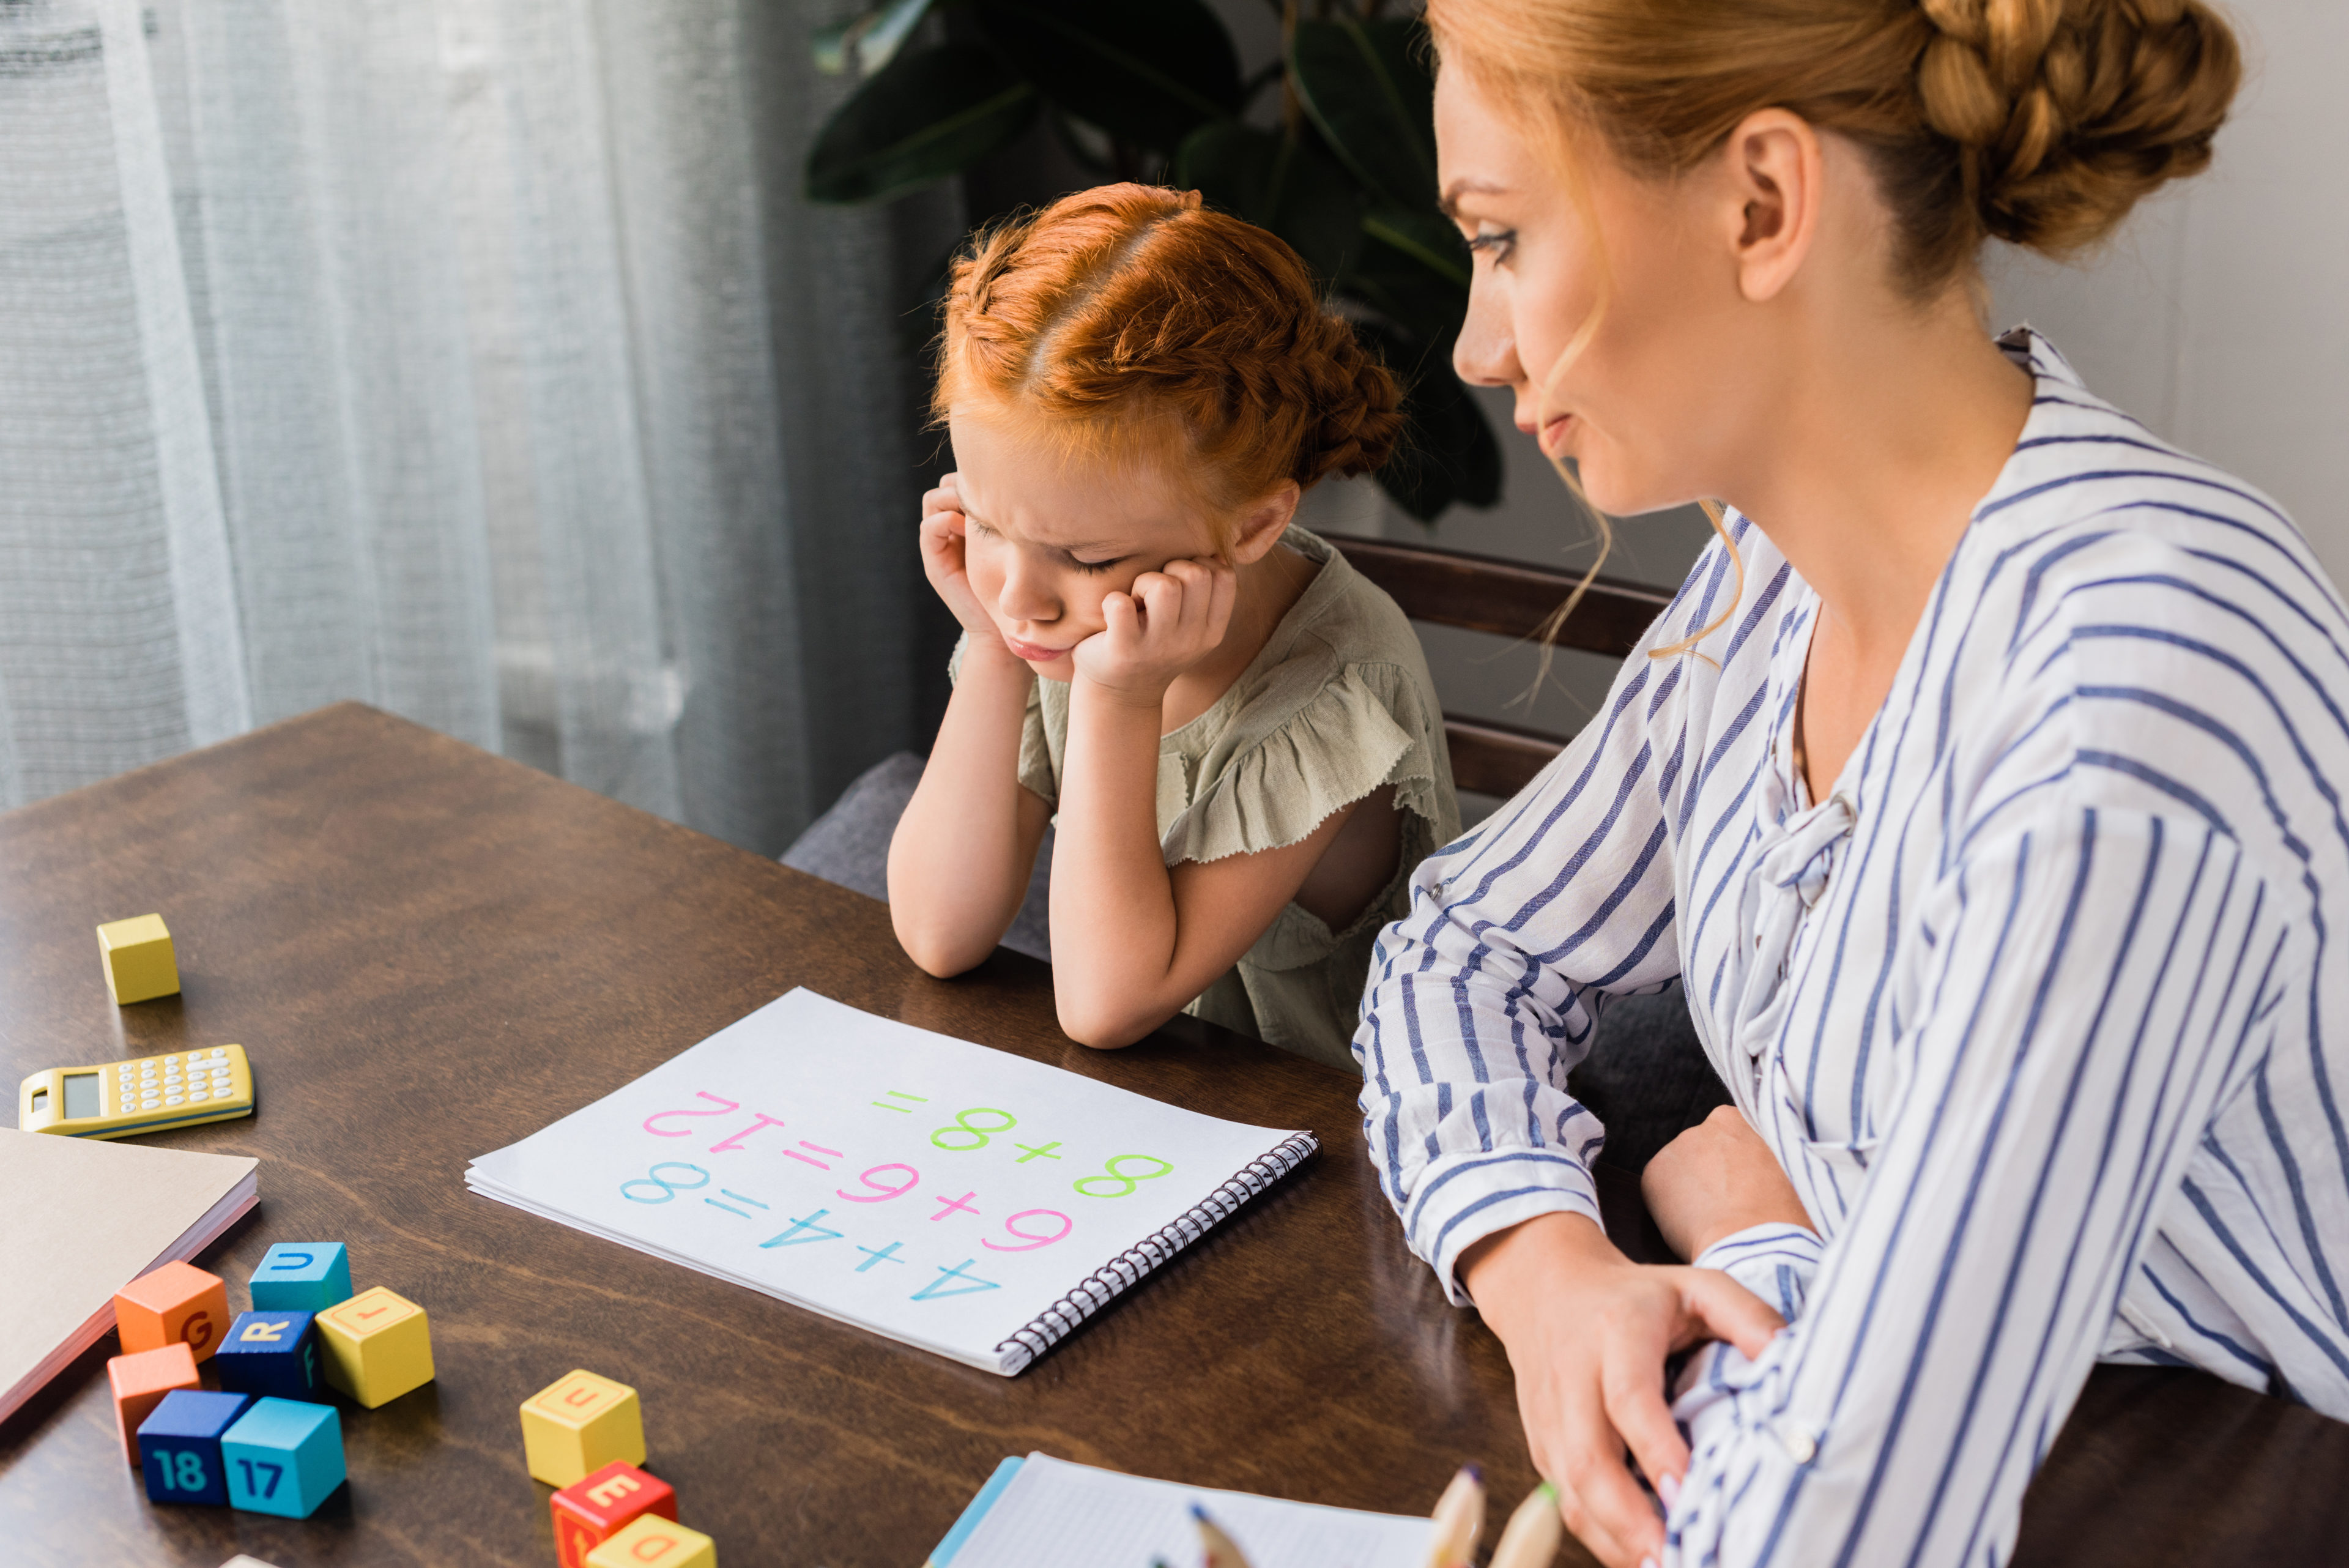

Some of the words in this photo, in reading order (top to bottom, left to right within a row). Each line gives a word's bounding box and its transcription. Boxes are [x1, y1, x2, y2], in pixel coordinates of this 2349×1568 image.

[180, 1310, 213, 1351] G
[239, 1320, 290, 1342] R
[152, 1450, 207, 1492] 18
[237, 1458, 284, 1499] 17
[585, 1473, 642, 1508] E
